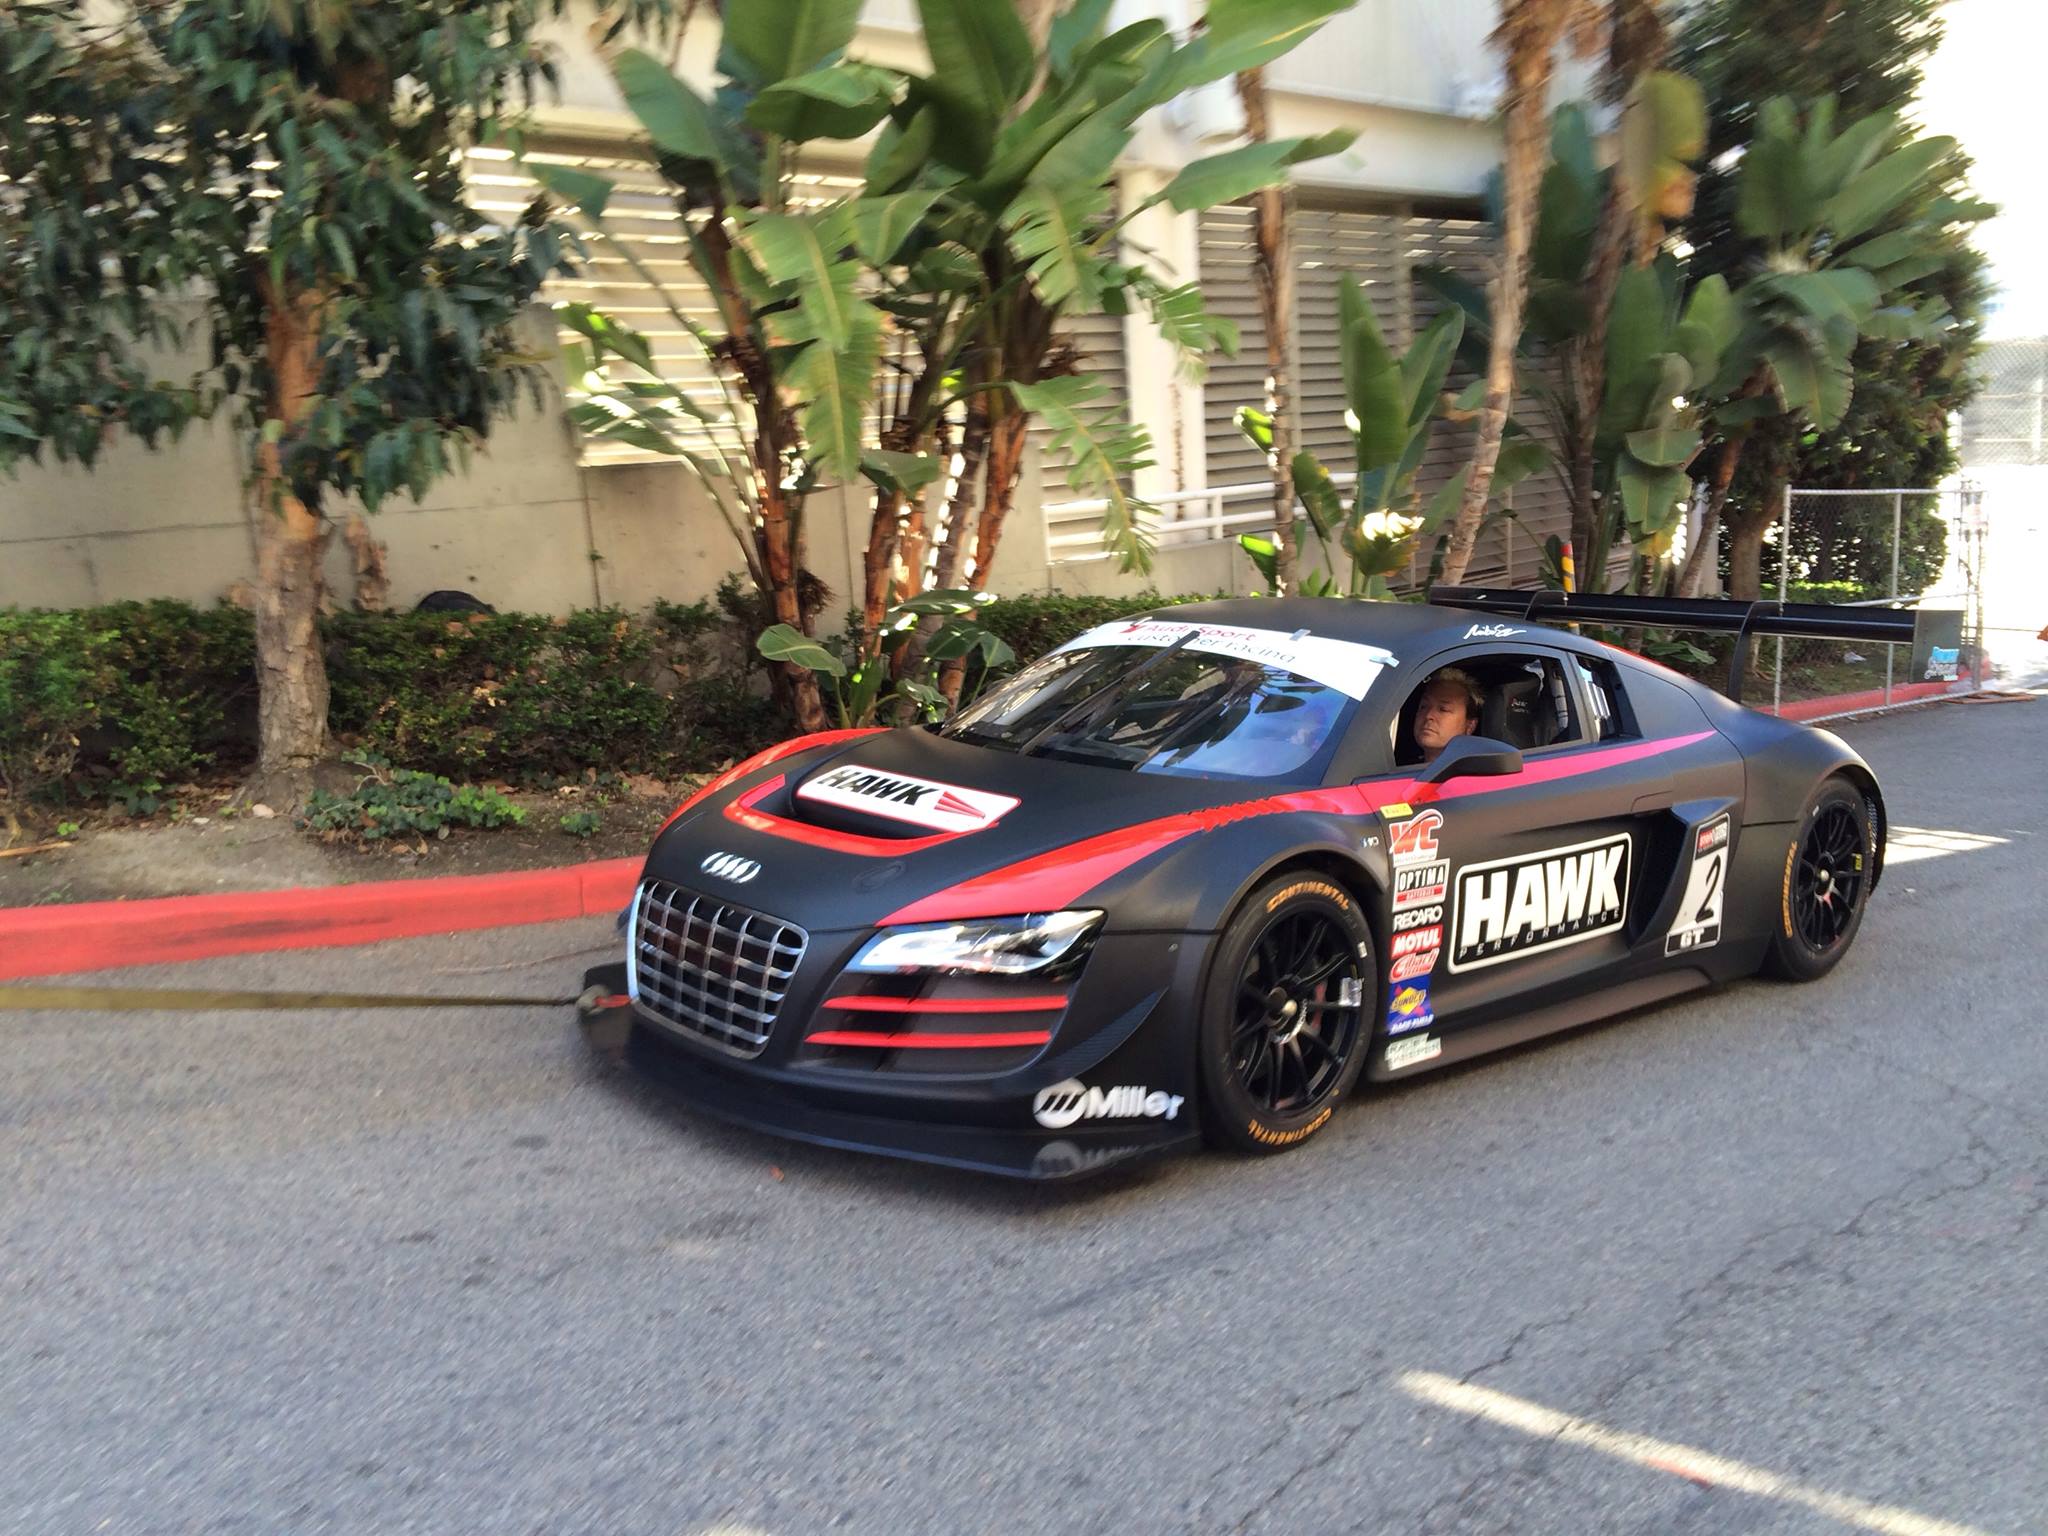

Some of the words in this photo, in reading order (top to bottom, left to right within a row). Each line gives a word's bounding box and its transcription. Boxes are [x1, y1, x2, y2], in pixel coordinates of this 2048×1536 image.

[1127, 633, 1221, 647] custoer
[1147, 624, 1189, 633] Audi
[1198, 626, 1257, 642] Sport
[817, 769, 939, 806] HAWK
[1399, 865, 1445, 891] OPTIMA
[1695, 854, 1721, 923] 2
[1266, 881, 1349, 913] CONTINENTAL
[1460, 844, 1625, 948] HAWK
[1392, 905, 1443, 932] RECARO
[1393, 928, 1440, 955] MOTUL
[1458, 906, 1621, 960] PERFORMANCE
[1680, 927, 1705, 948] GT
[1392, 991, 1426, 1009] SUNOCO
[1083, 1085, 1185, 1121] Miller
